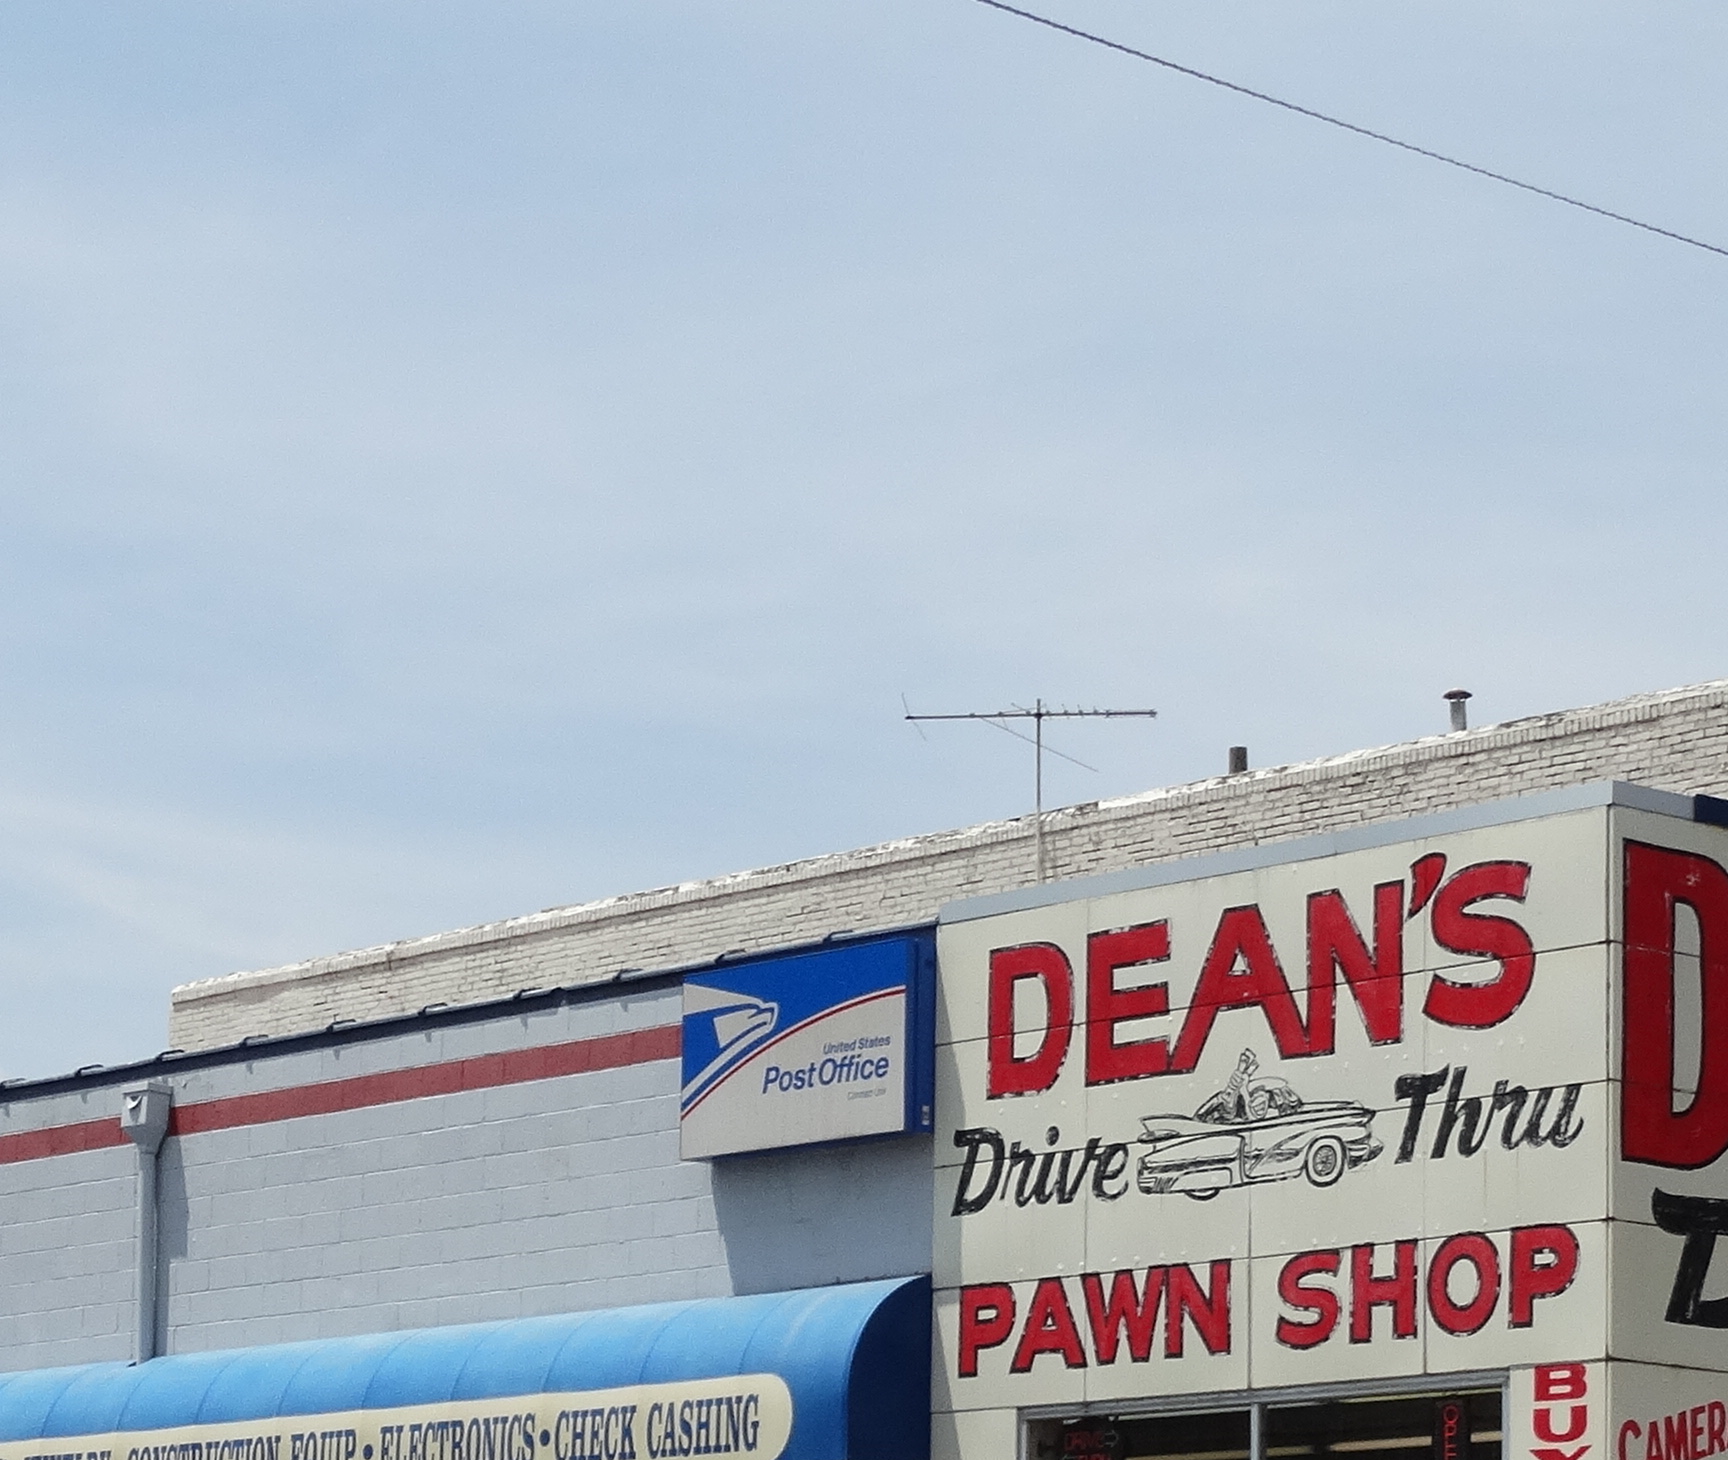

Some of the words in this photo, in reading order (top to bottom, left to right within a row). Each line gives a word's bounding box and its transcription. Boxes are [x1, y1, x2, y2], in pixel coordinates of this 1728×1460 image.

[986, 853, 1535, 1100] DEAN'S
[762, 1062, 816, 1094] Post
[818, 1053, 889, 1086] Office
[823, 1040, 856, 1054] United
[858, 1035, 891, 1050] States
[950, 1126, 1129, 1217] Drive
[1394, 1065, 1584, 1164] Thru
[958, 1257, 1232, 1378] PAWN
[1275, 1223, 1580, 1350] SHOP
[646, 1393, 760, 1459] CASHING
